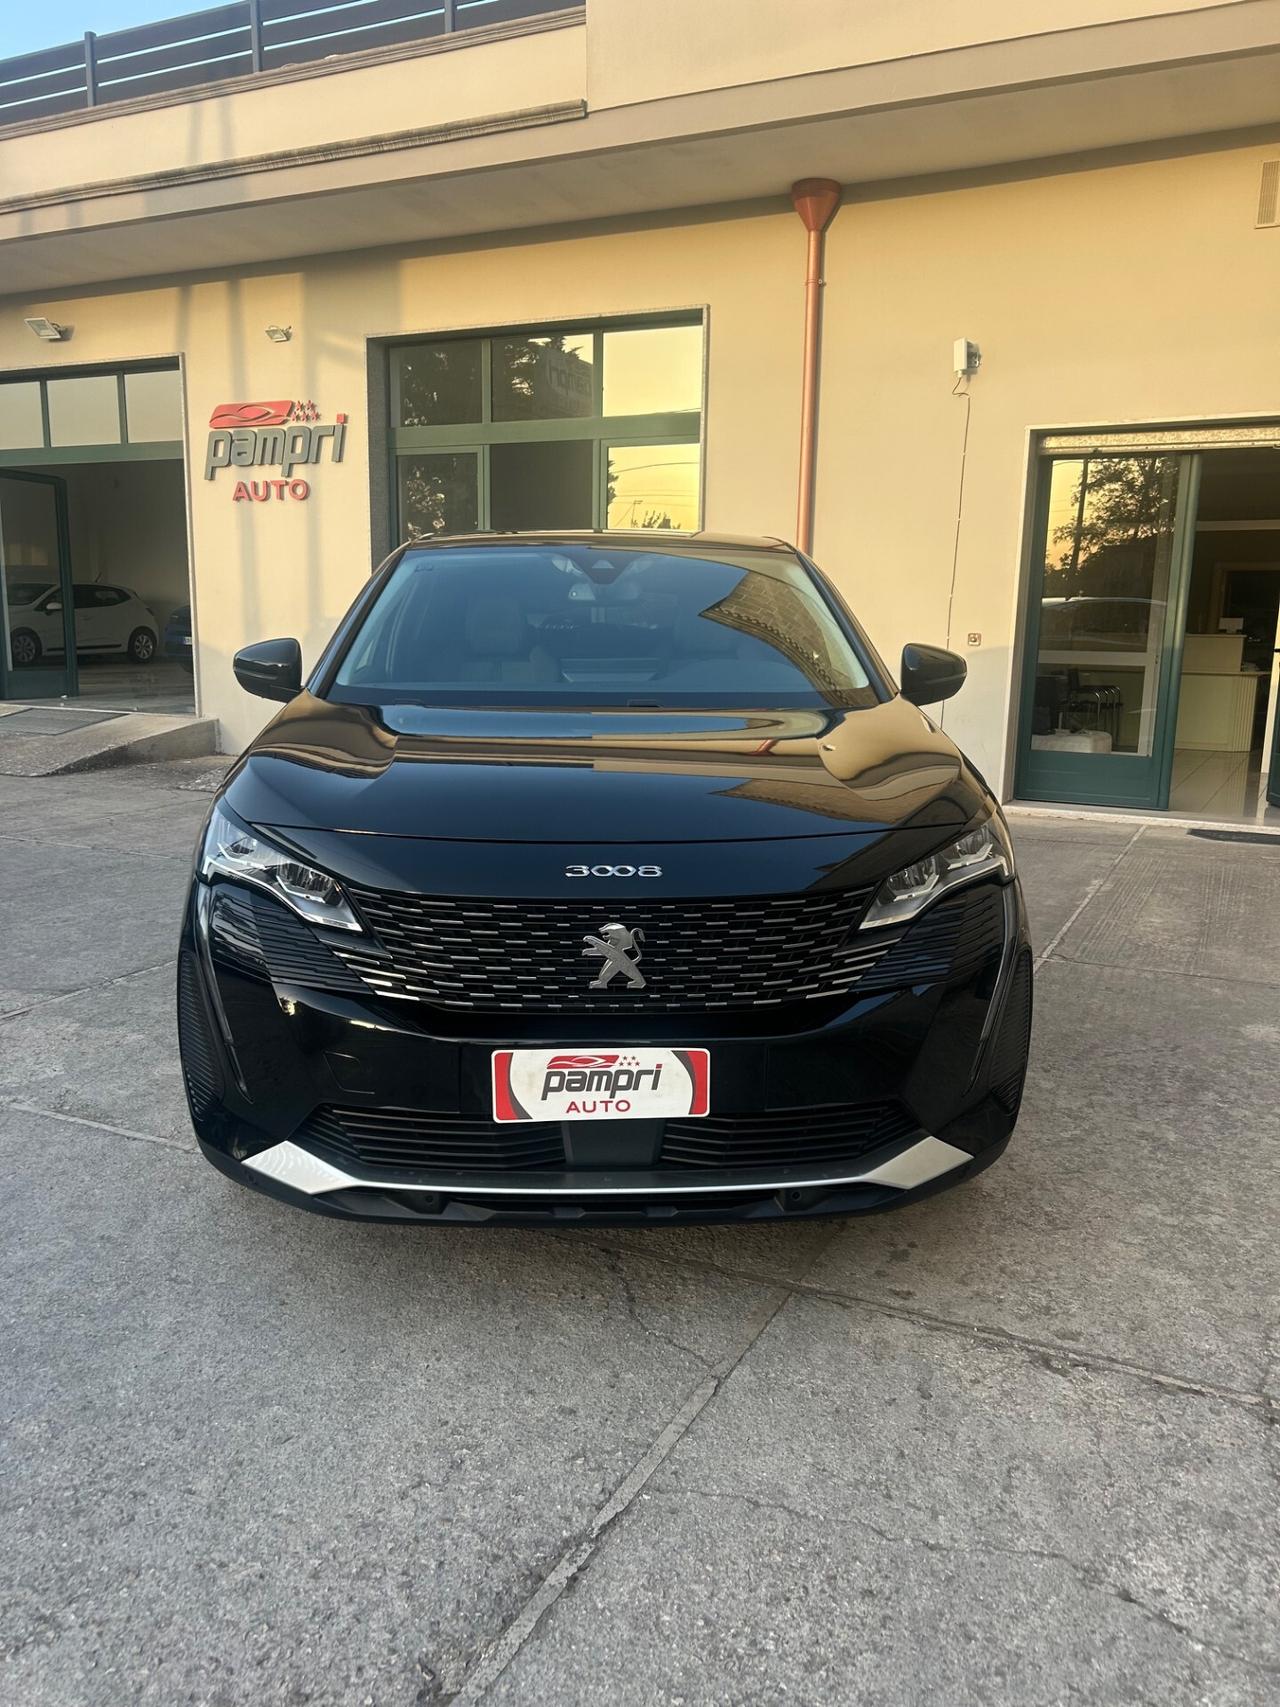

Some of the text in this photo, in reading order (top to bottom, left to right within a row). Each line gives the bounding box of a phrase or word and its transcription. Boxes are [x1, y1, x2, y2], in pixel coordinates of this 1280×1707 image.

[205, 413, 346, 480] pampri
[232, 479, 309, 501] AUTO
[565, 865, 662, 877] 3008
[541, 1063, 663, 1100] pampri
[566, 1100, 631, 1113] AUTO
